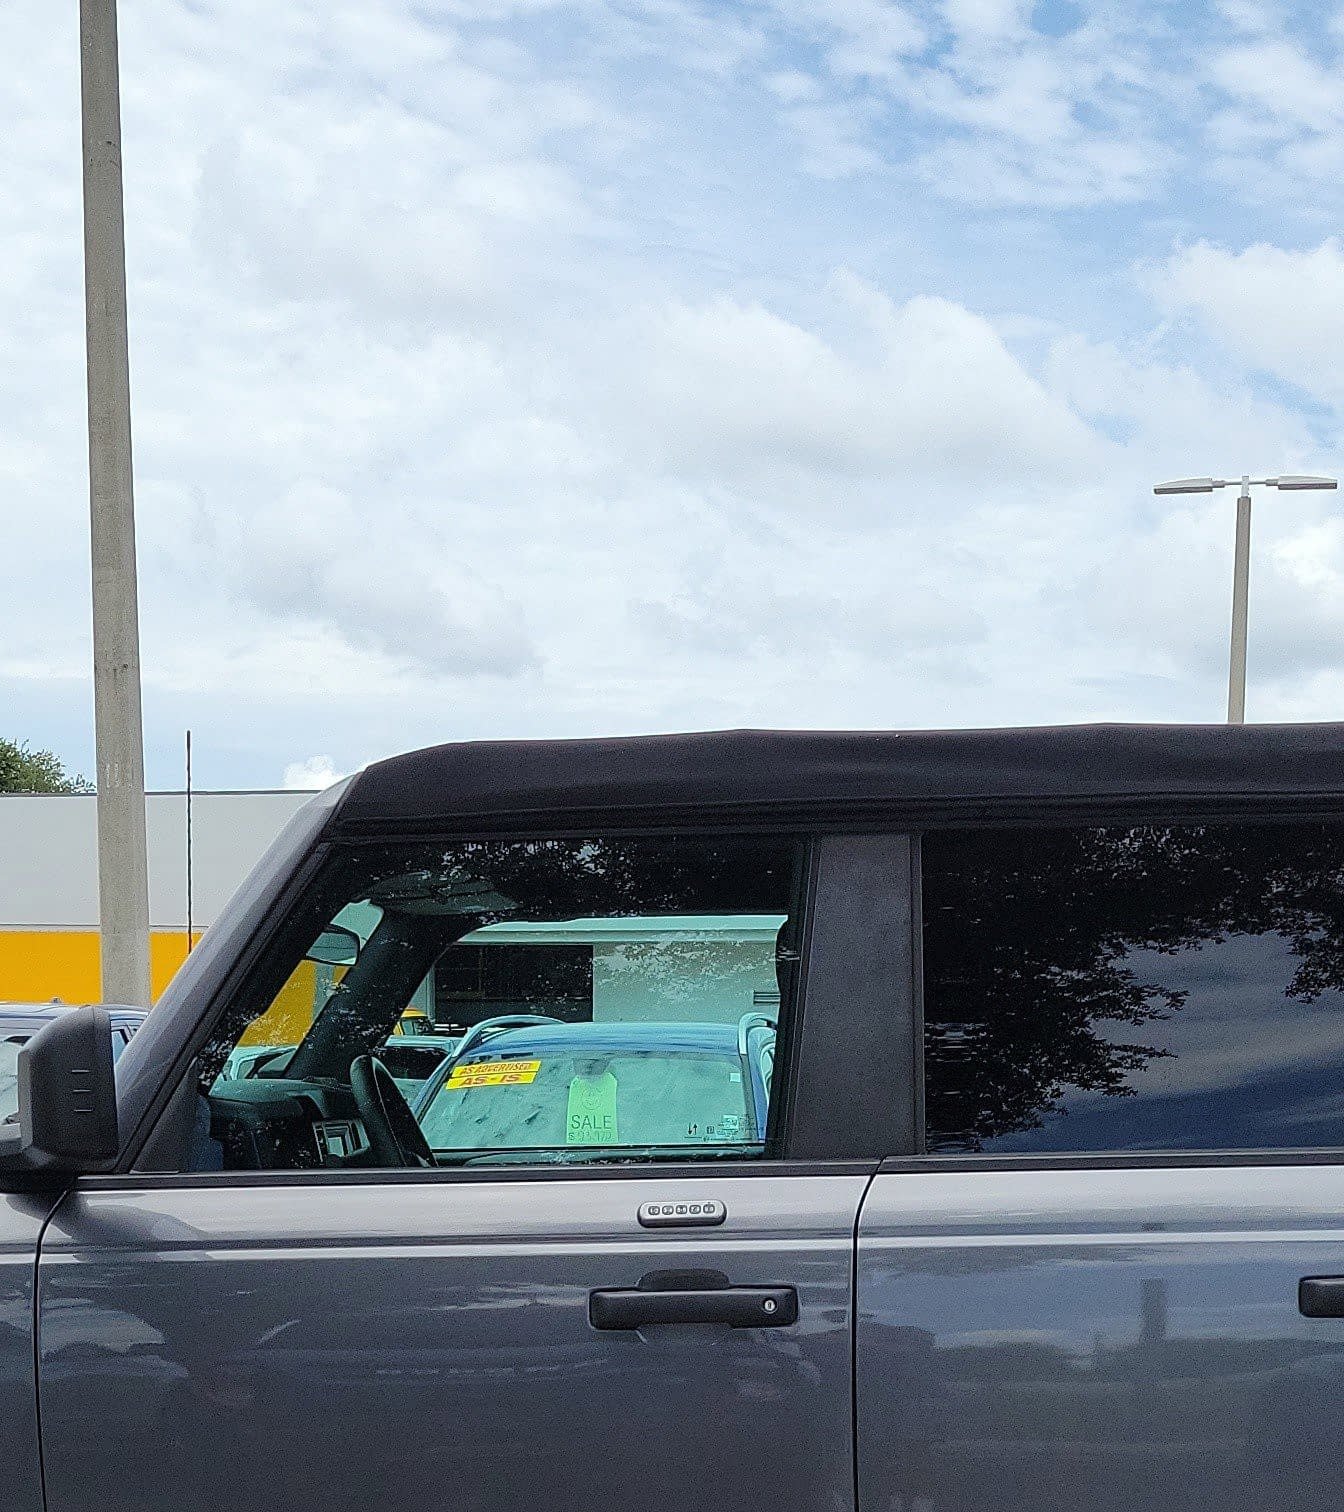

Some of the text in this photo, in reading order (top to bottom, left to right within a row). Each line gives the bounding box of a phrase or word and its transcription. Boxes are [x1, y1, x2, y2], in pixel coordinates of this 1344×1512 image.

[459, 1062, 533, 1076] AS ADVERTISED
[571, 1114, 612, 1130] SALE
